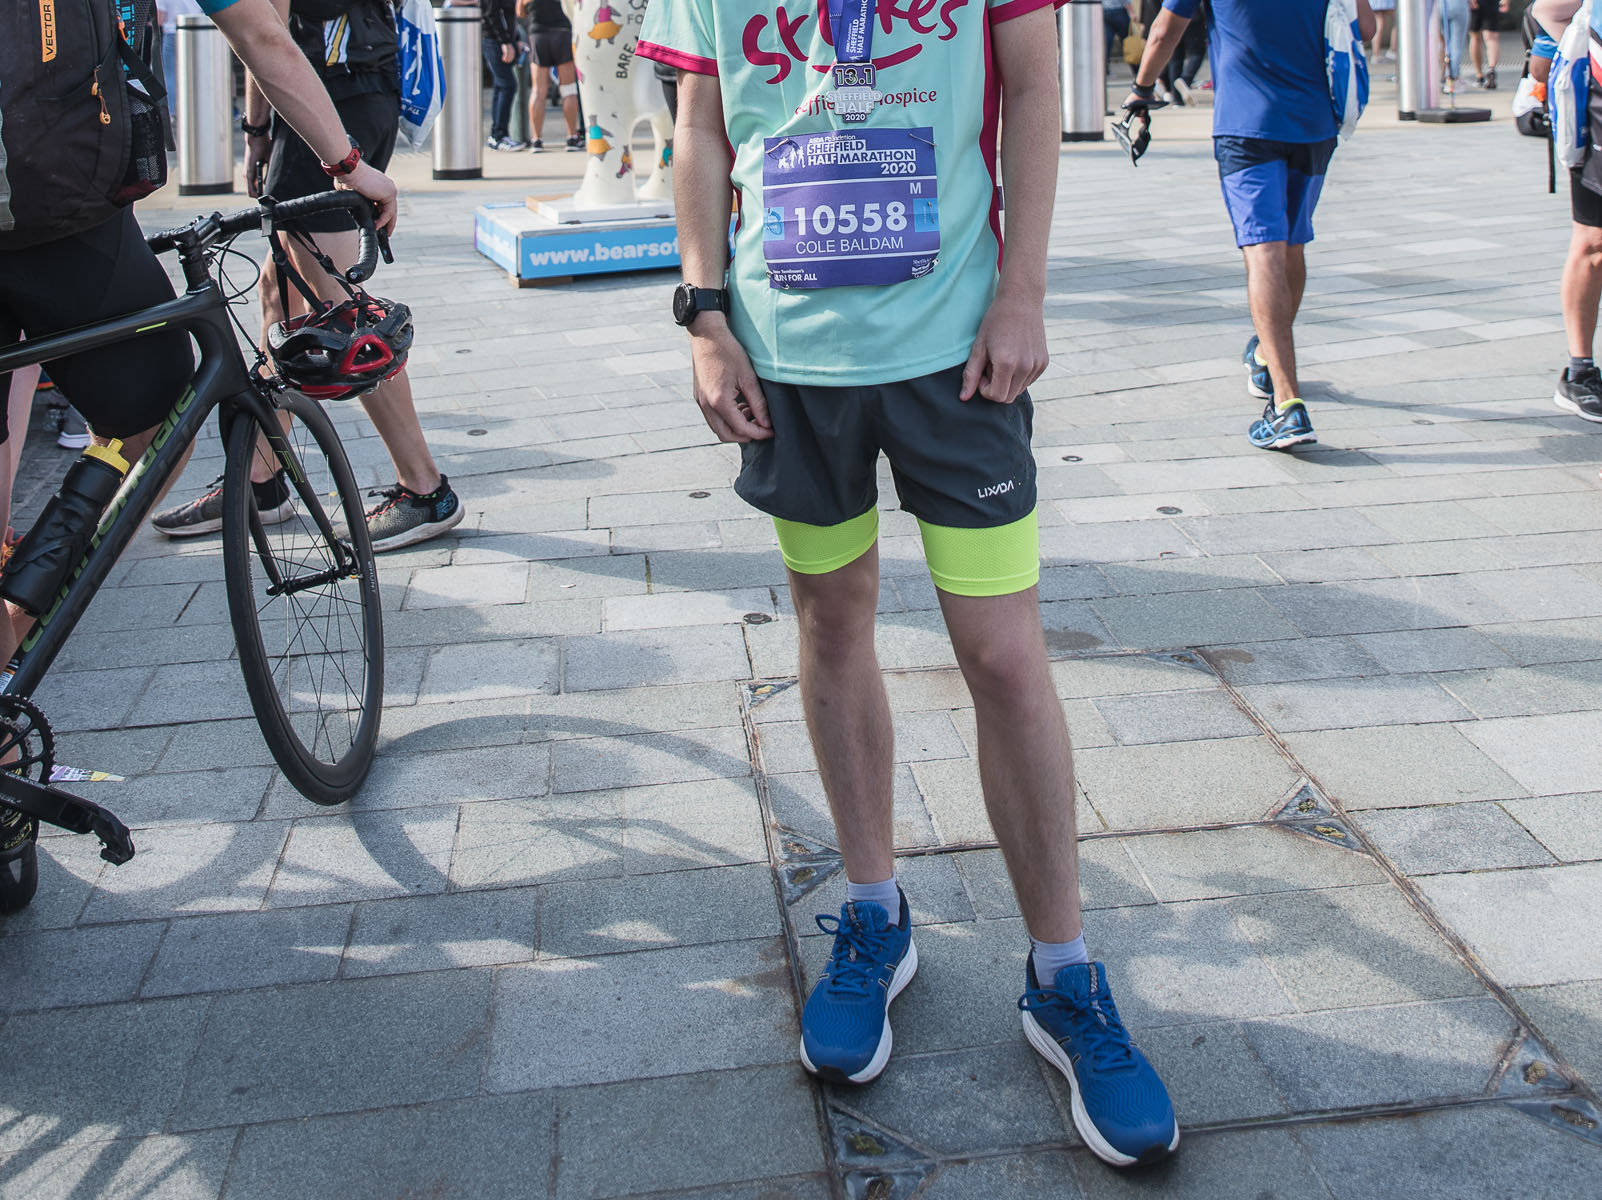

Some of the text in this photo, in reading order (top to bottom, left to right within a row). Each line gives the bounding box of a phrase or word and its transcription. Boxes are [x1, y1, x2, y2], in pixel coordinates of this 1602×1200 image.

[43, 4, 54, 56] VECTOR
[850, 18, 860, 53] SHEFFIELD
[855, 34, 865, 54] HALF
[835, 68, 873, 86] 13.1
[827, 92, 881, 102] SHEFFIELD
[880, 88, 938, 108] ospice
[835, 102, 873, 113] HALF
[845, 113, 866, 121] 2020
[808, 140, 865, 155] SHEFFIELD
[808, 150, 915, 167] HALF MARATHON
[880, 163, 917, 175] 2020
[909, 182, 922, 195] M
[794, 200, 908, 236] 10558
[529, 237, 680, 267] www.bearsof
[795, 236, 904, 254] COLE BALDAM
[788, 273, 803, 281] FOR
[804, 272, 818, 281] ALL
